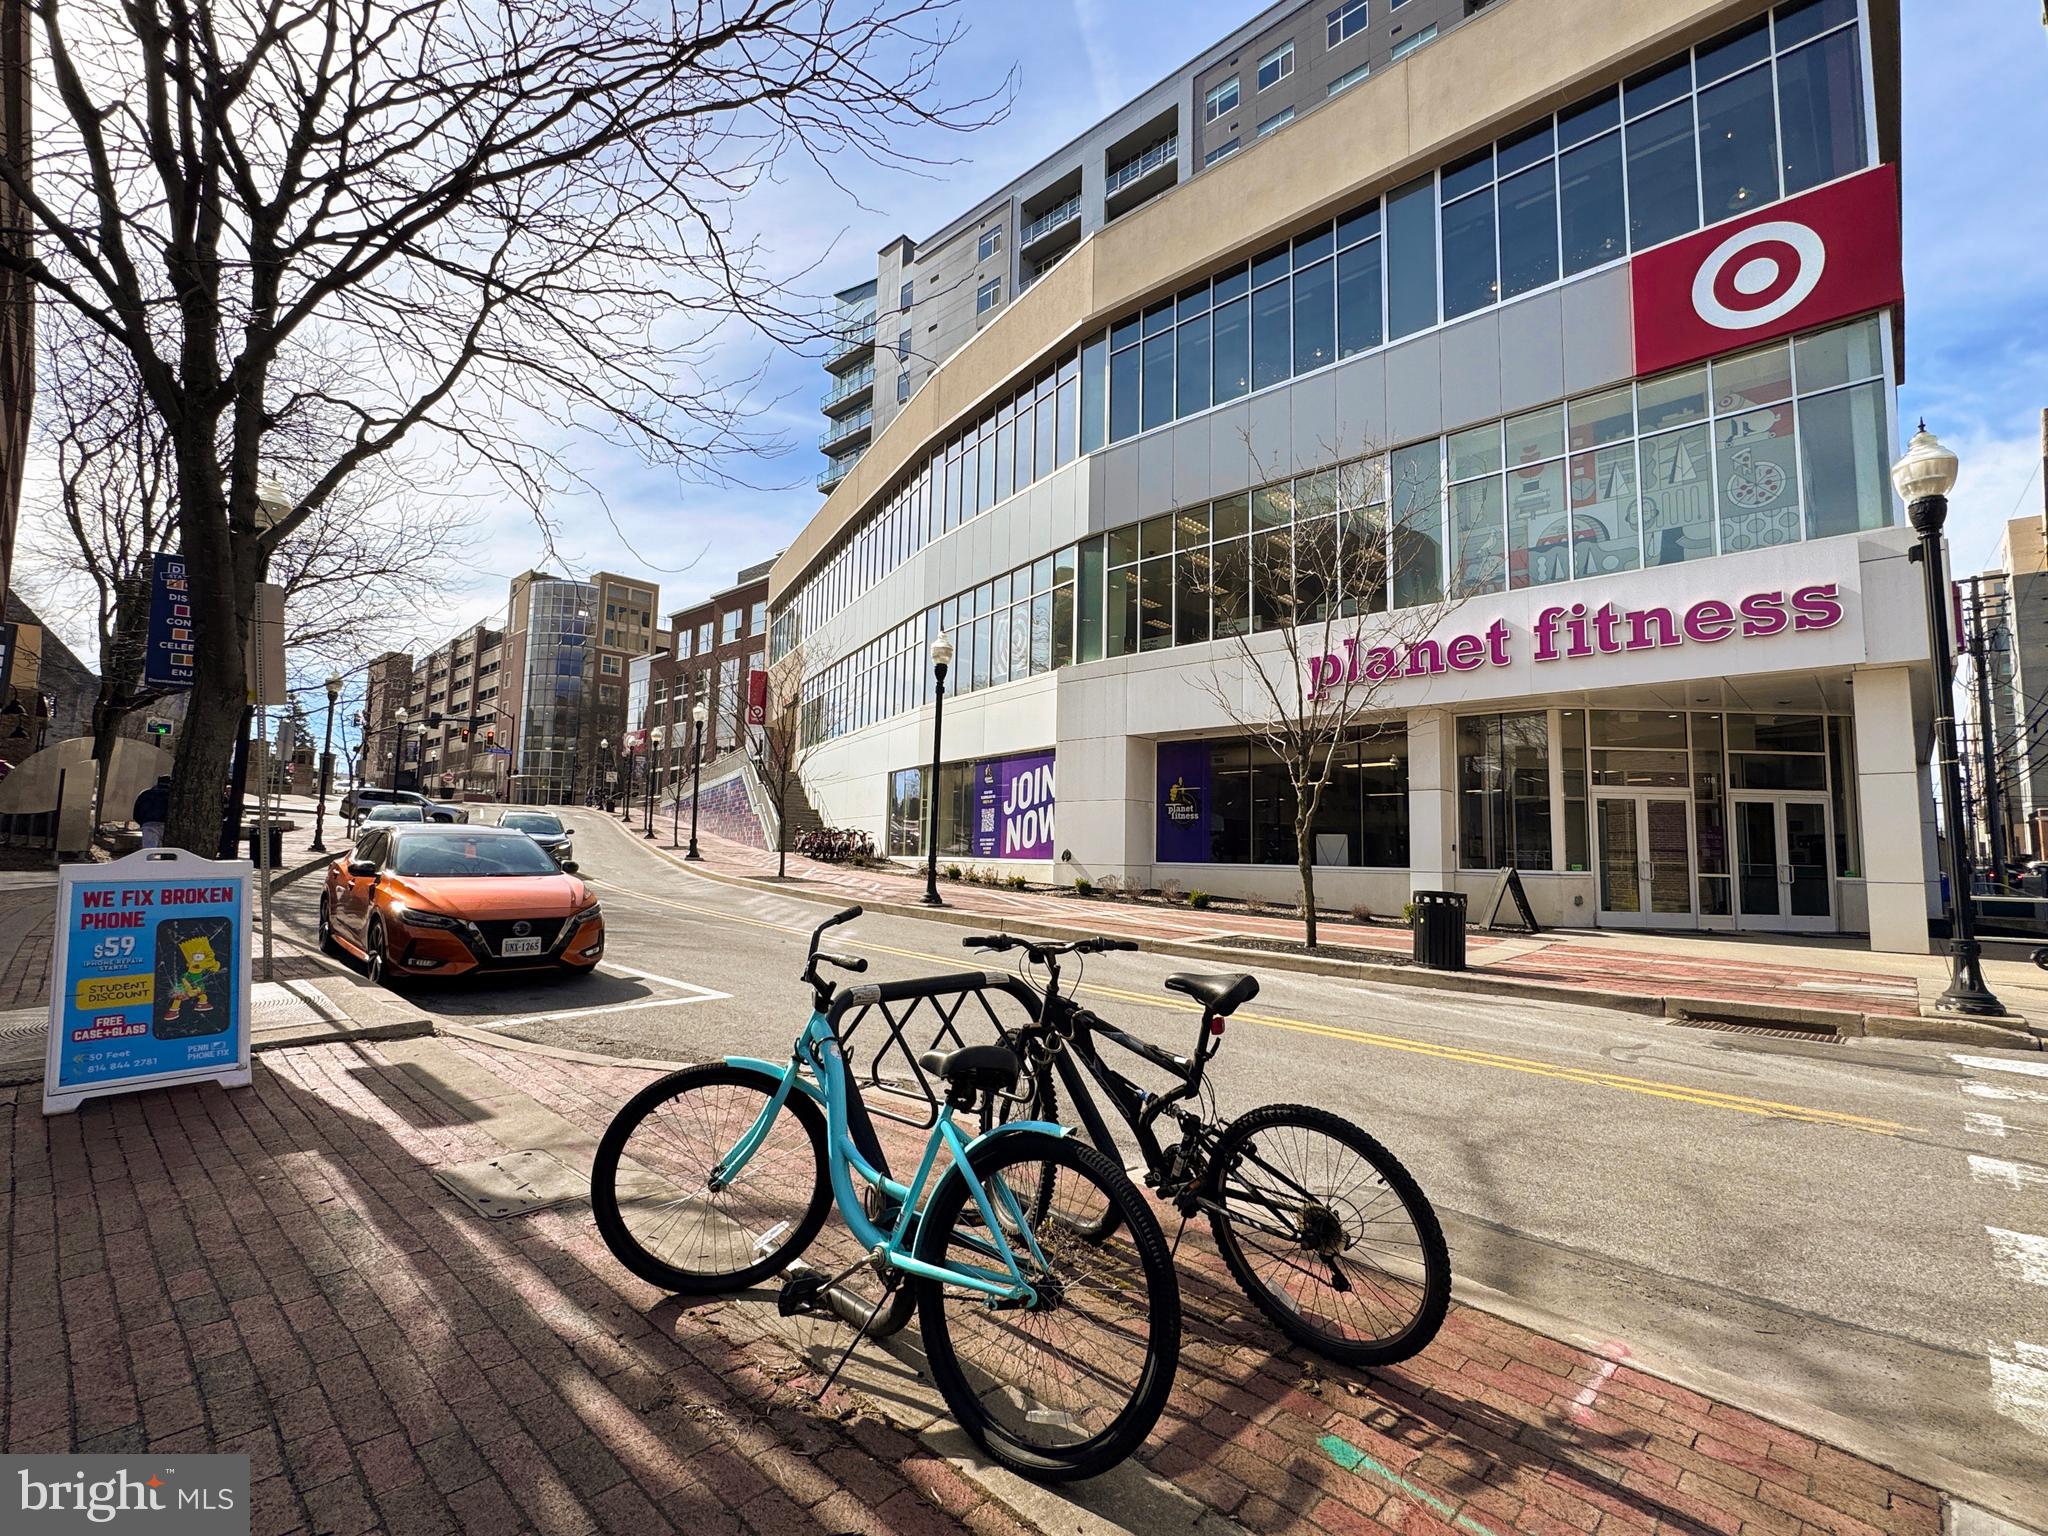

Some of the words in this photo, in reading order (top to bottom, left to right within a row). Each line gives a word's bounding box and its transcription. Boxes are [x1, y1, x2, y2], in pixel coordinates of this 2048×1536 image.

[169, 593, 188, 603] DIS
[166, 617, 192, 627] CON
[1307, 617, 1511, 700] planet
[1533, 582, 1845, 661] fitness
[171, 668, 193, 677] ENJ
[1003, 761, 1056, 815] JOIN
[1167, 804, 1194, 815] planet
[1171, 812, 1199, 820] fitness
[1005, 803, 1056, 854] NOW
[83, 890, 115, 908] WE
[121, 888, 154, 907] FIX
[160, 886, 233, 905] BROKEN
[80, 911, 146, 931] PHONE
[94, 936, 136, 959] $59
[89, 981, 148, 994] STUDENT
[88, 989, 150, 1003] DISCOUNT
[96, 1016, 123, 1027] FREE
[74, 1024, 146, 1041] CASE+GLASS
